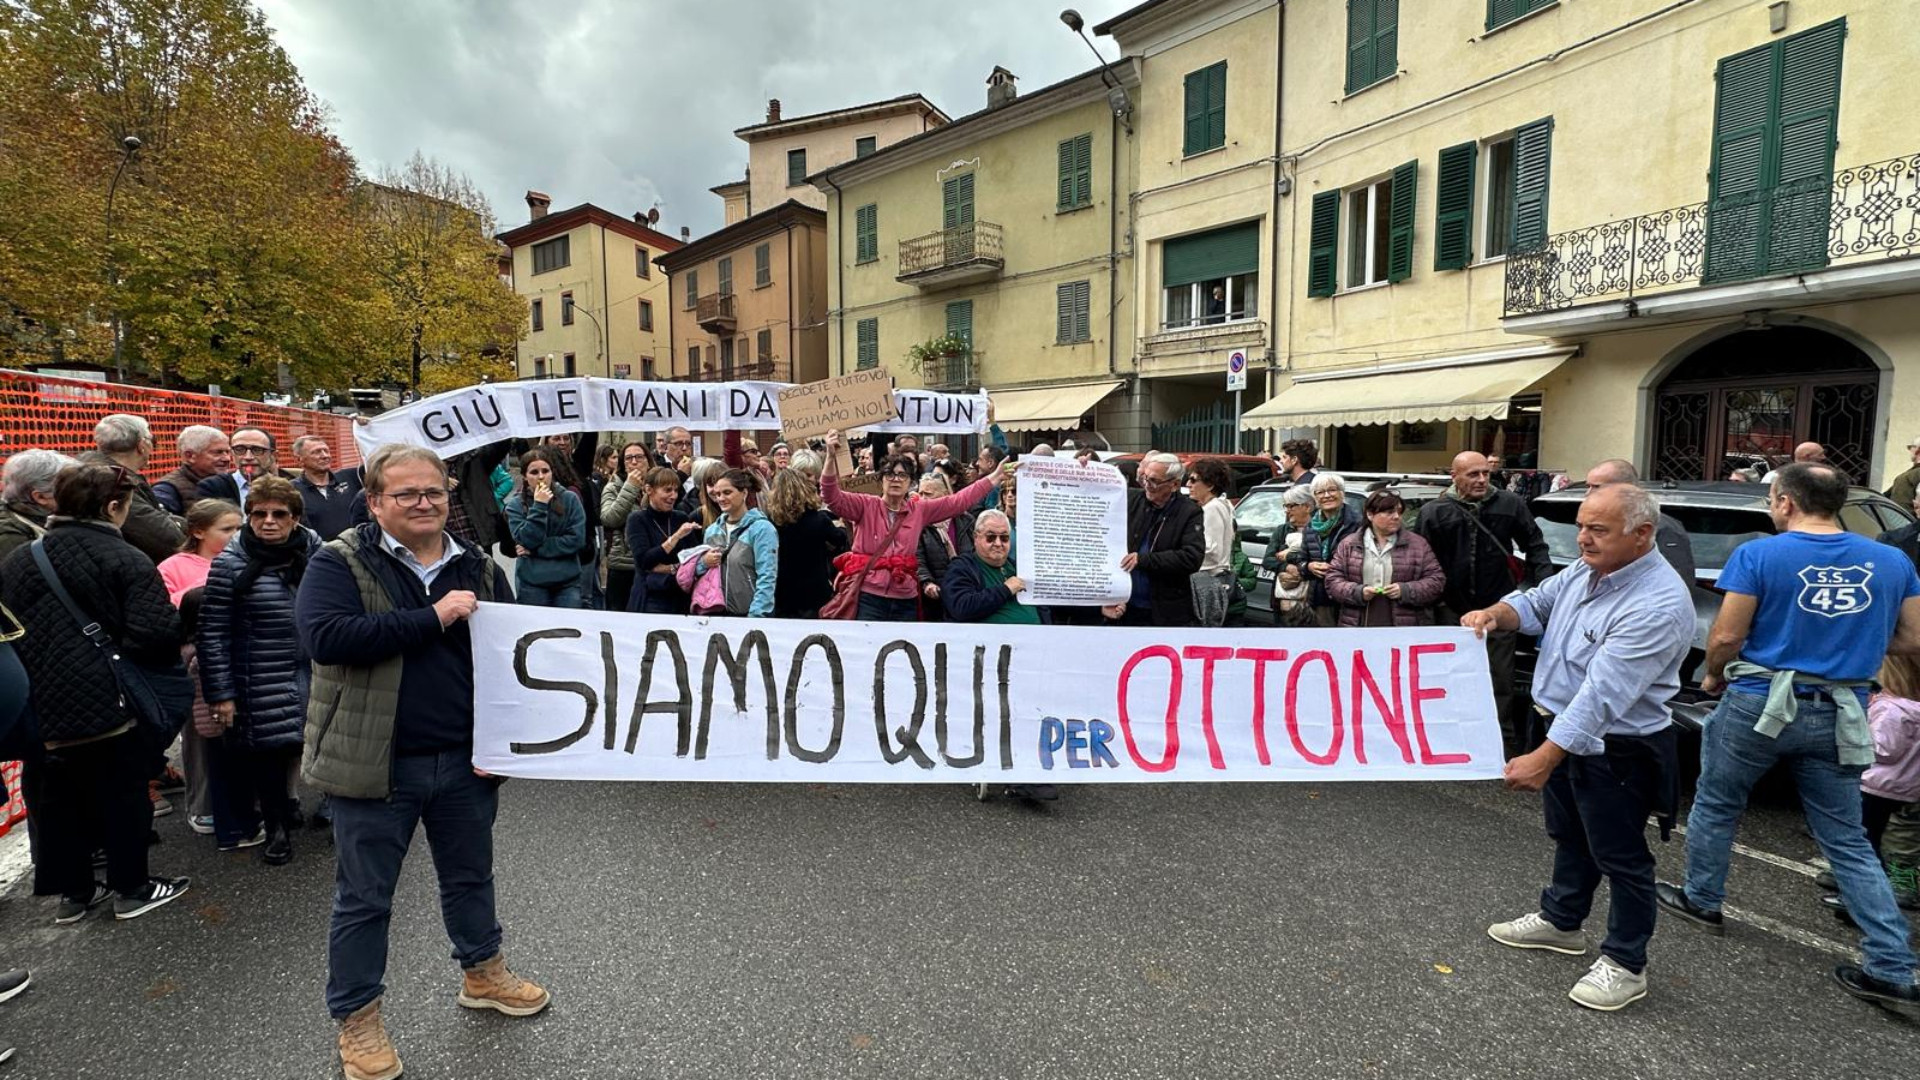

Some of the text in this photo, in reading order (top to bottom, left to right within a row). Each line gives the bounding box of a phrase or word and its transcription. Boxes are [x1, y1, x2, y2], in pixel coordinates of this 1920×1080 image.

[778, 369, 888, 402] DECIDETE TUTTO VOI
[421, 388, 974, 442] GIÙ LE MANI DA NTUN
[783, 394, 892, 433] PAGHIAMO NOI!
[1817, 571, 1850, 584] S.S.
[1810, 587, 1857, 611] 45
[509, 627, 1472, 774] SIAMO QUI PER OTTONE
